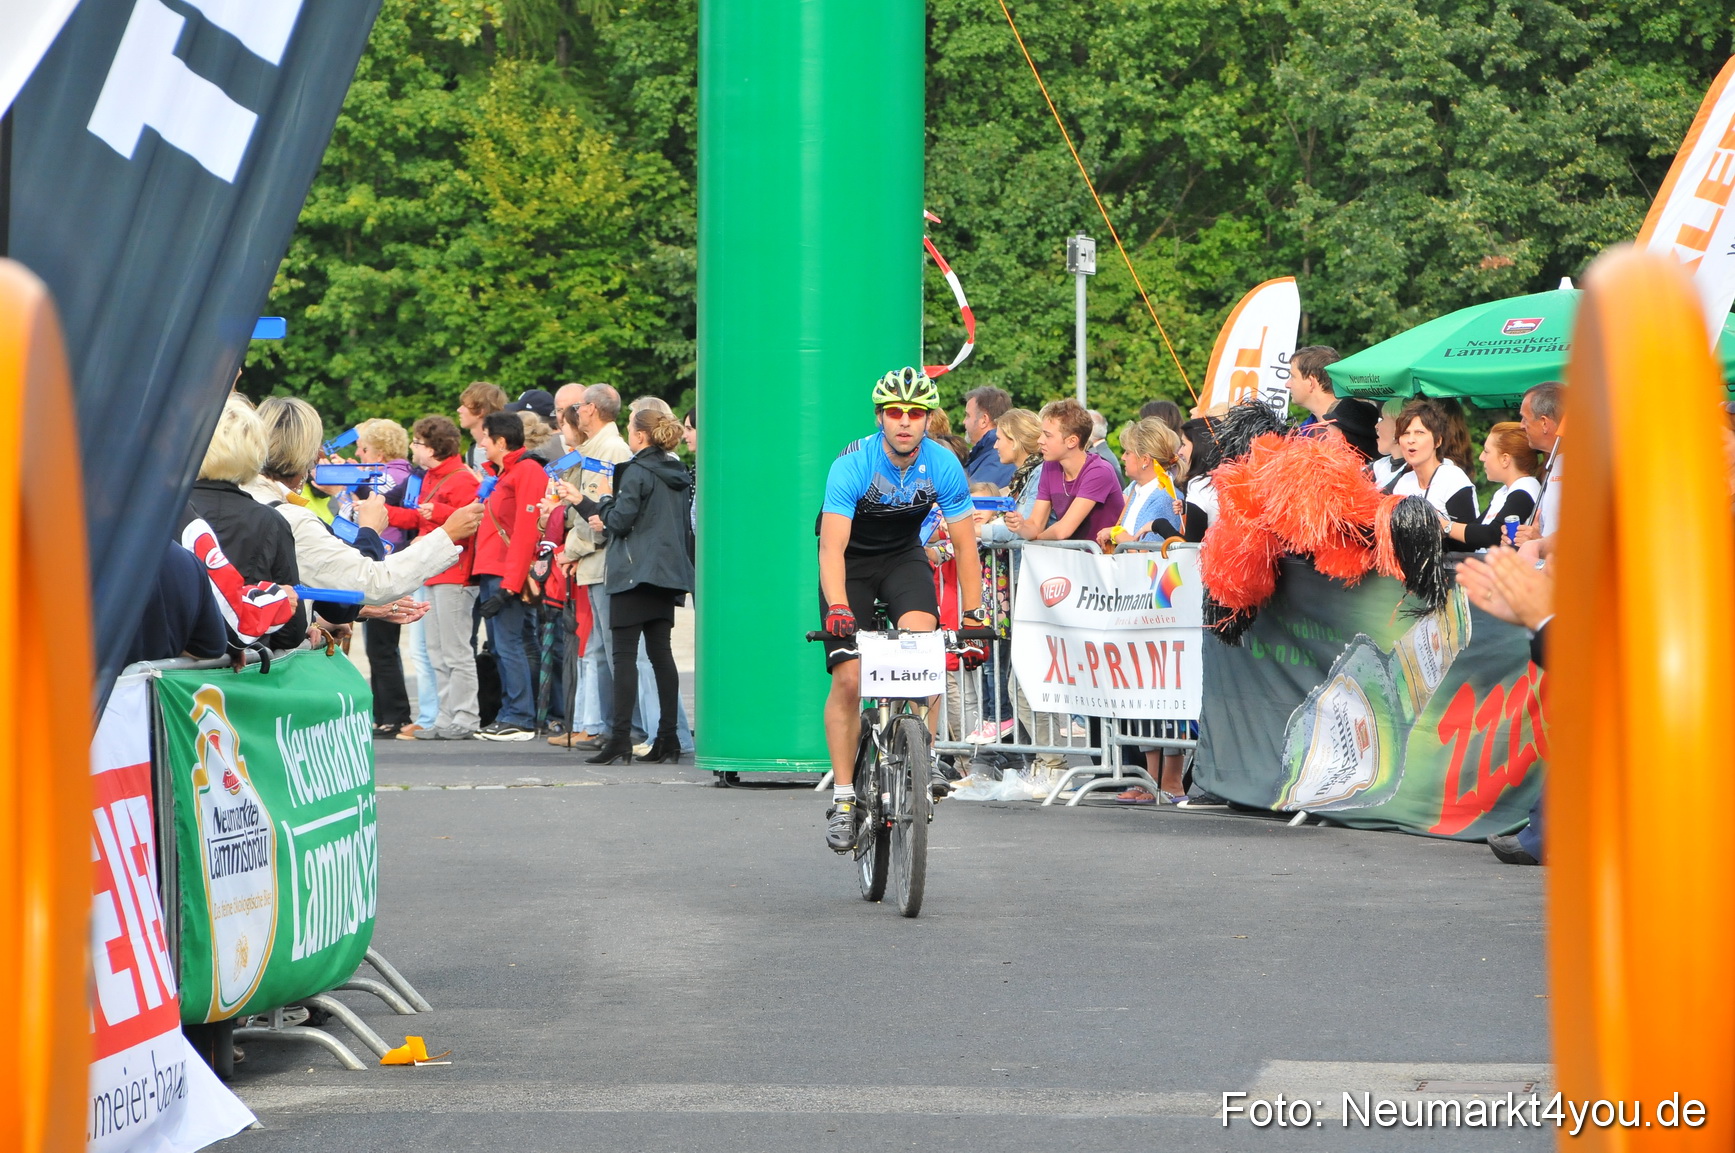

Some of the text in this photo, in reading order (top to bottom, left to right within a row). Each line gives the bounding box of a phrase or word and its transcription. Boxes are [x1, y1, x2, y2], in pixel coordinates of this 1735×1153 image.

[1467, 336, 1560, 346] Neumarkter
[1444, 343, 1572, 358] Lammsbräu
[1043, 583, 1066, 600] NEU!
[1076, 586, 1154, 612] Frischmann
[1141, 614, 1177, 625] Medien
[1043, 635, 1185, 690] XL-PRINT
[869, 670, 884, 681] 1.
[1042, 692, 1186, 710] WWW.FRISCHMANN-NET.DE
[213, 798, 260, 836] Neumarkter
[207, 829, 269, 880] Lammsbräu
